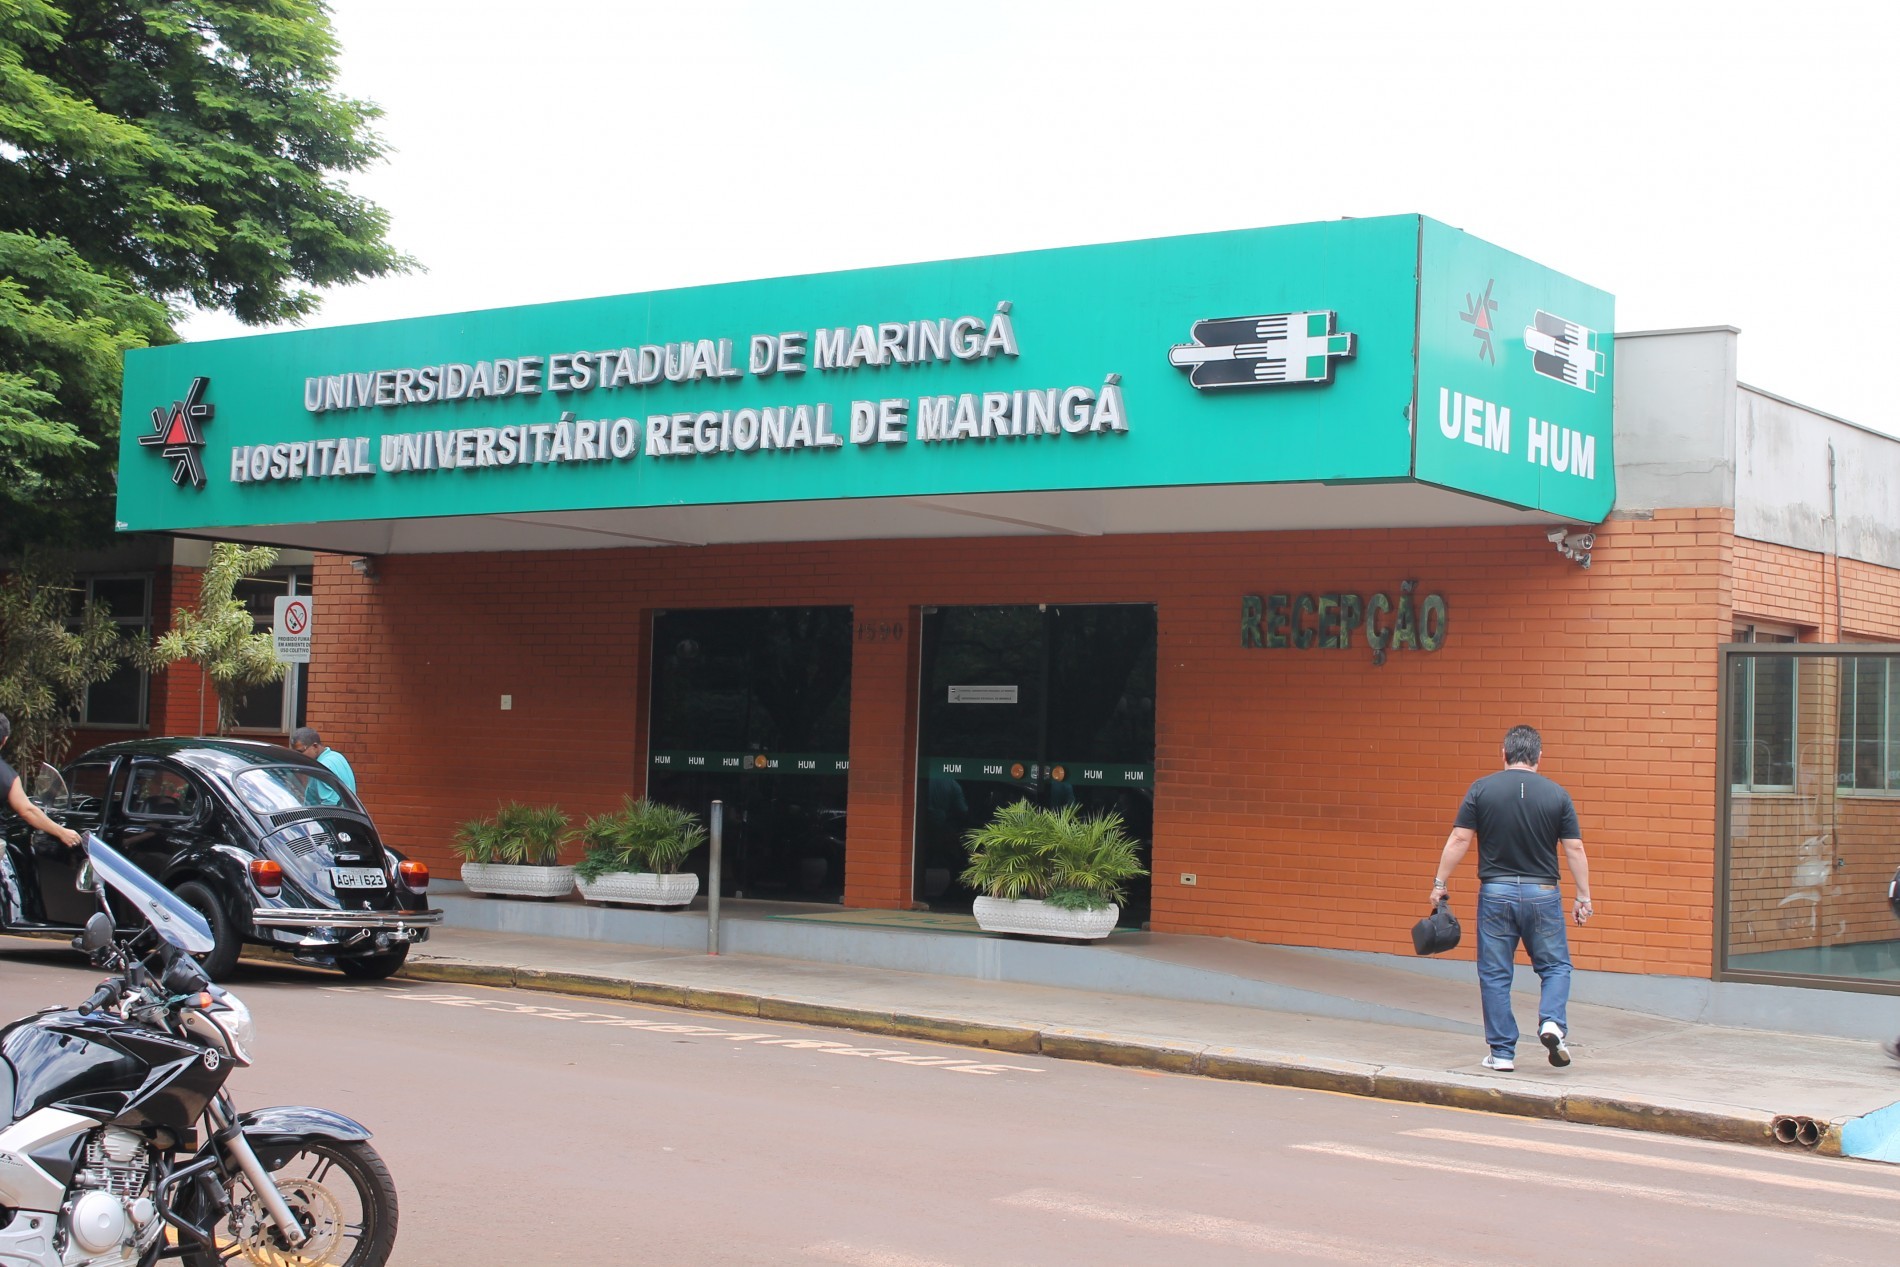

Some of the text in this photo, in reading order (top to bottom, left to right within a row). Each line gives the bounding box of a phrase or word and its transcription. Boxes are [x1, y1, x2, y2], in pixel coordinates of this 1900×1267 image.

[305, 300, 1019, 412] UNIVERSIDADE ESTADUAL DE MARINGÁ
[230, 373, 1129, 484] HOSPITAL UNIVERSITÁRIO REGIONAL DE MARINGÁ
[1439, 387, 1595, 480] UEM HUM
[857, 622, 903, 641] 1590
[1240, 577, 1449, 666] RECEPÇÃO
[654, 755, 671, 764] HUM
[688, 756, 705, 765] HUM
[722, 758, 739, 766] HUM
[798, 760, 816, 769] HUM
[943, 764, 1144, 780] HUM HUM HUM HUM
